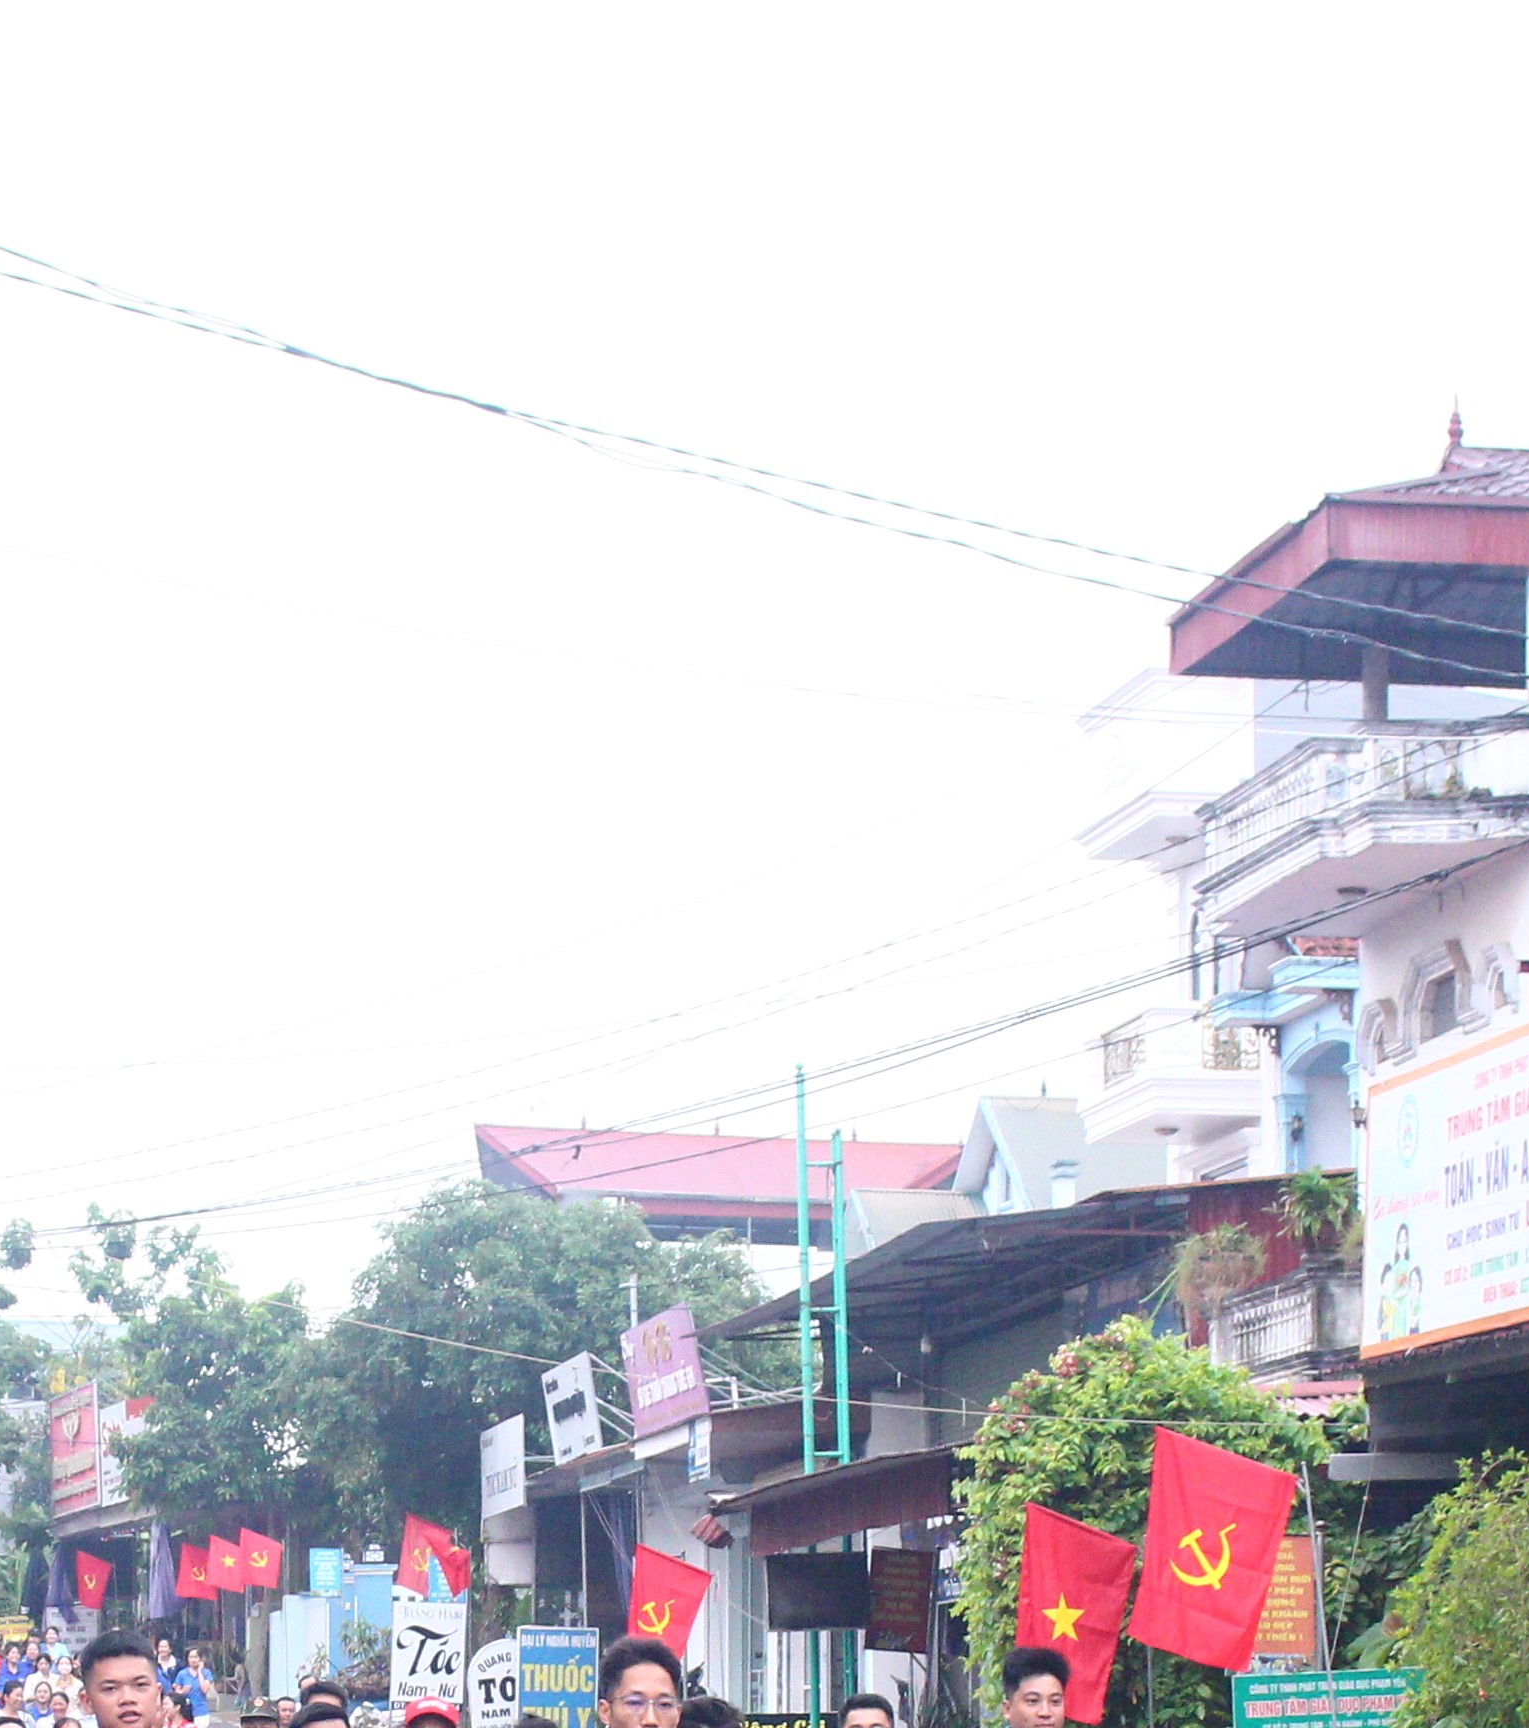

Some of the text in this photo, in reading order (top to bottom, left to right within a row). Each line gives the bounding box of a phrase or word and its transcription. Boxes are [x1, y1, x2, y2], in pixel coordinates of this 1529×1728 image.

[1447, 1107, 1483, 1143] TRUNG
[1444, 1151, 1475, 1209] TOÁN
[1485, 1138, 1510, 1195] VĂN
[396, 1625, 463, 1677] Tóc
[477, 1652, 512, 1673] QUANG
[521, 1654, 594, 1693] THUỐC
[397, 1680, 457, 1699] Nam Nữ
[481, 1708, 511, 1720] NAM
[1246, 1700, 1283, 1719] TRUNG
[1283, 1696, 1308, 1717] TÂM
[1360, 1694, 1395, 1716] PHẠM
